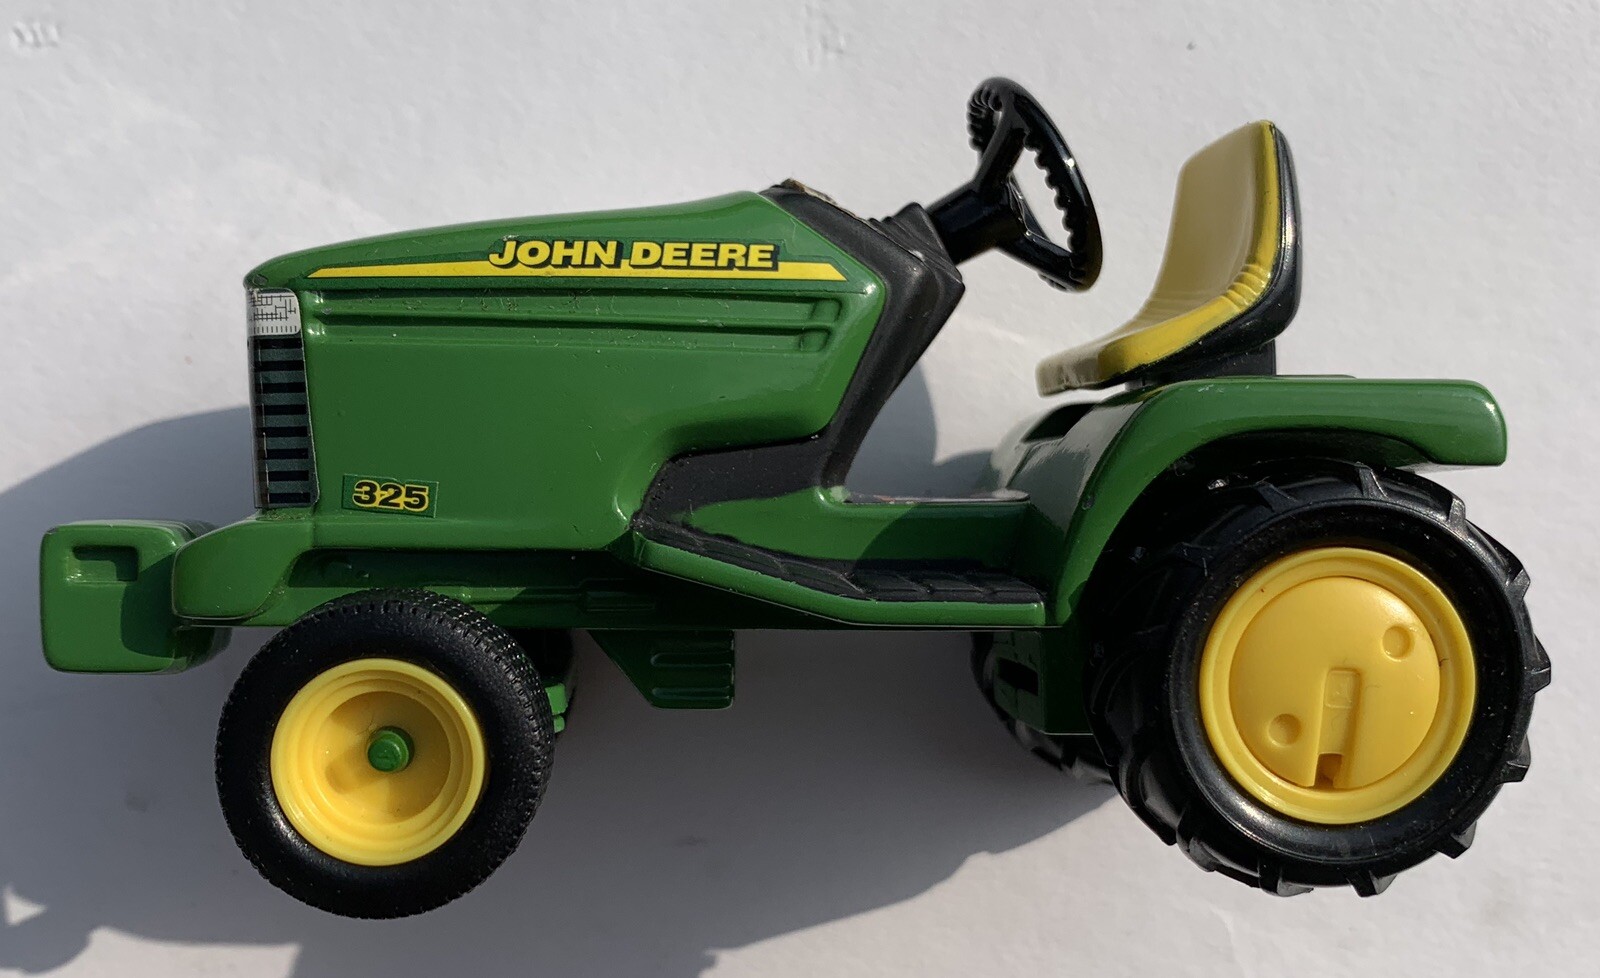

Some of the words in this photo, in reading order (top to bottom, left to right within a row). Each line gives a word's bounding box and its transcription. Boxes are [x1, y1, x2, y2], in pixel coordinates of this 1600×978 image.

[488, 239, 621, 269] JOHN
[629, 240, 777, 271] DEERE
[352, 479, 429, 512] 325
